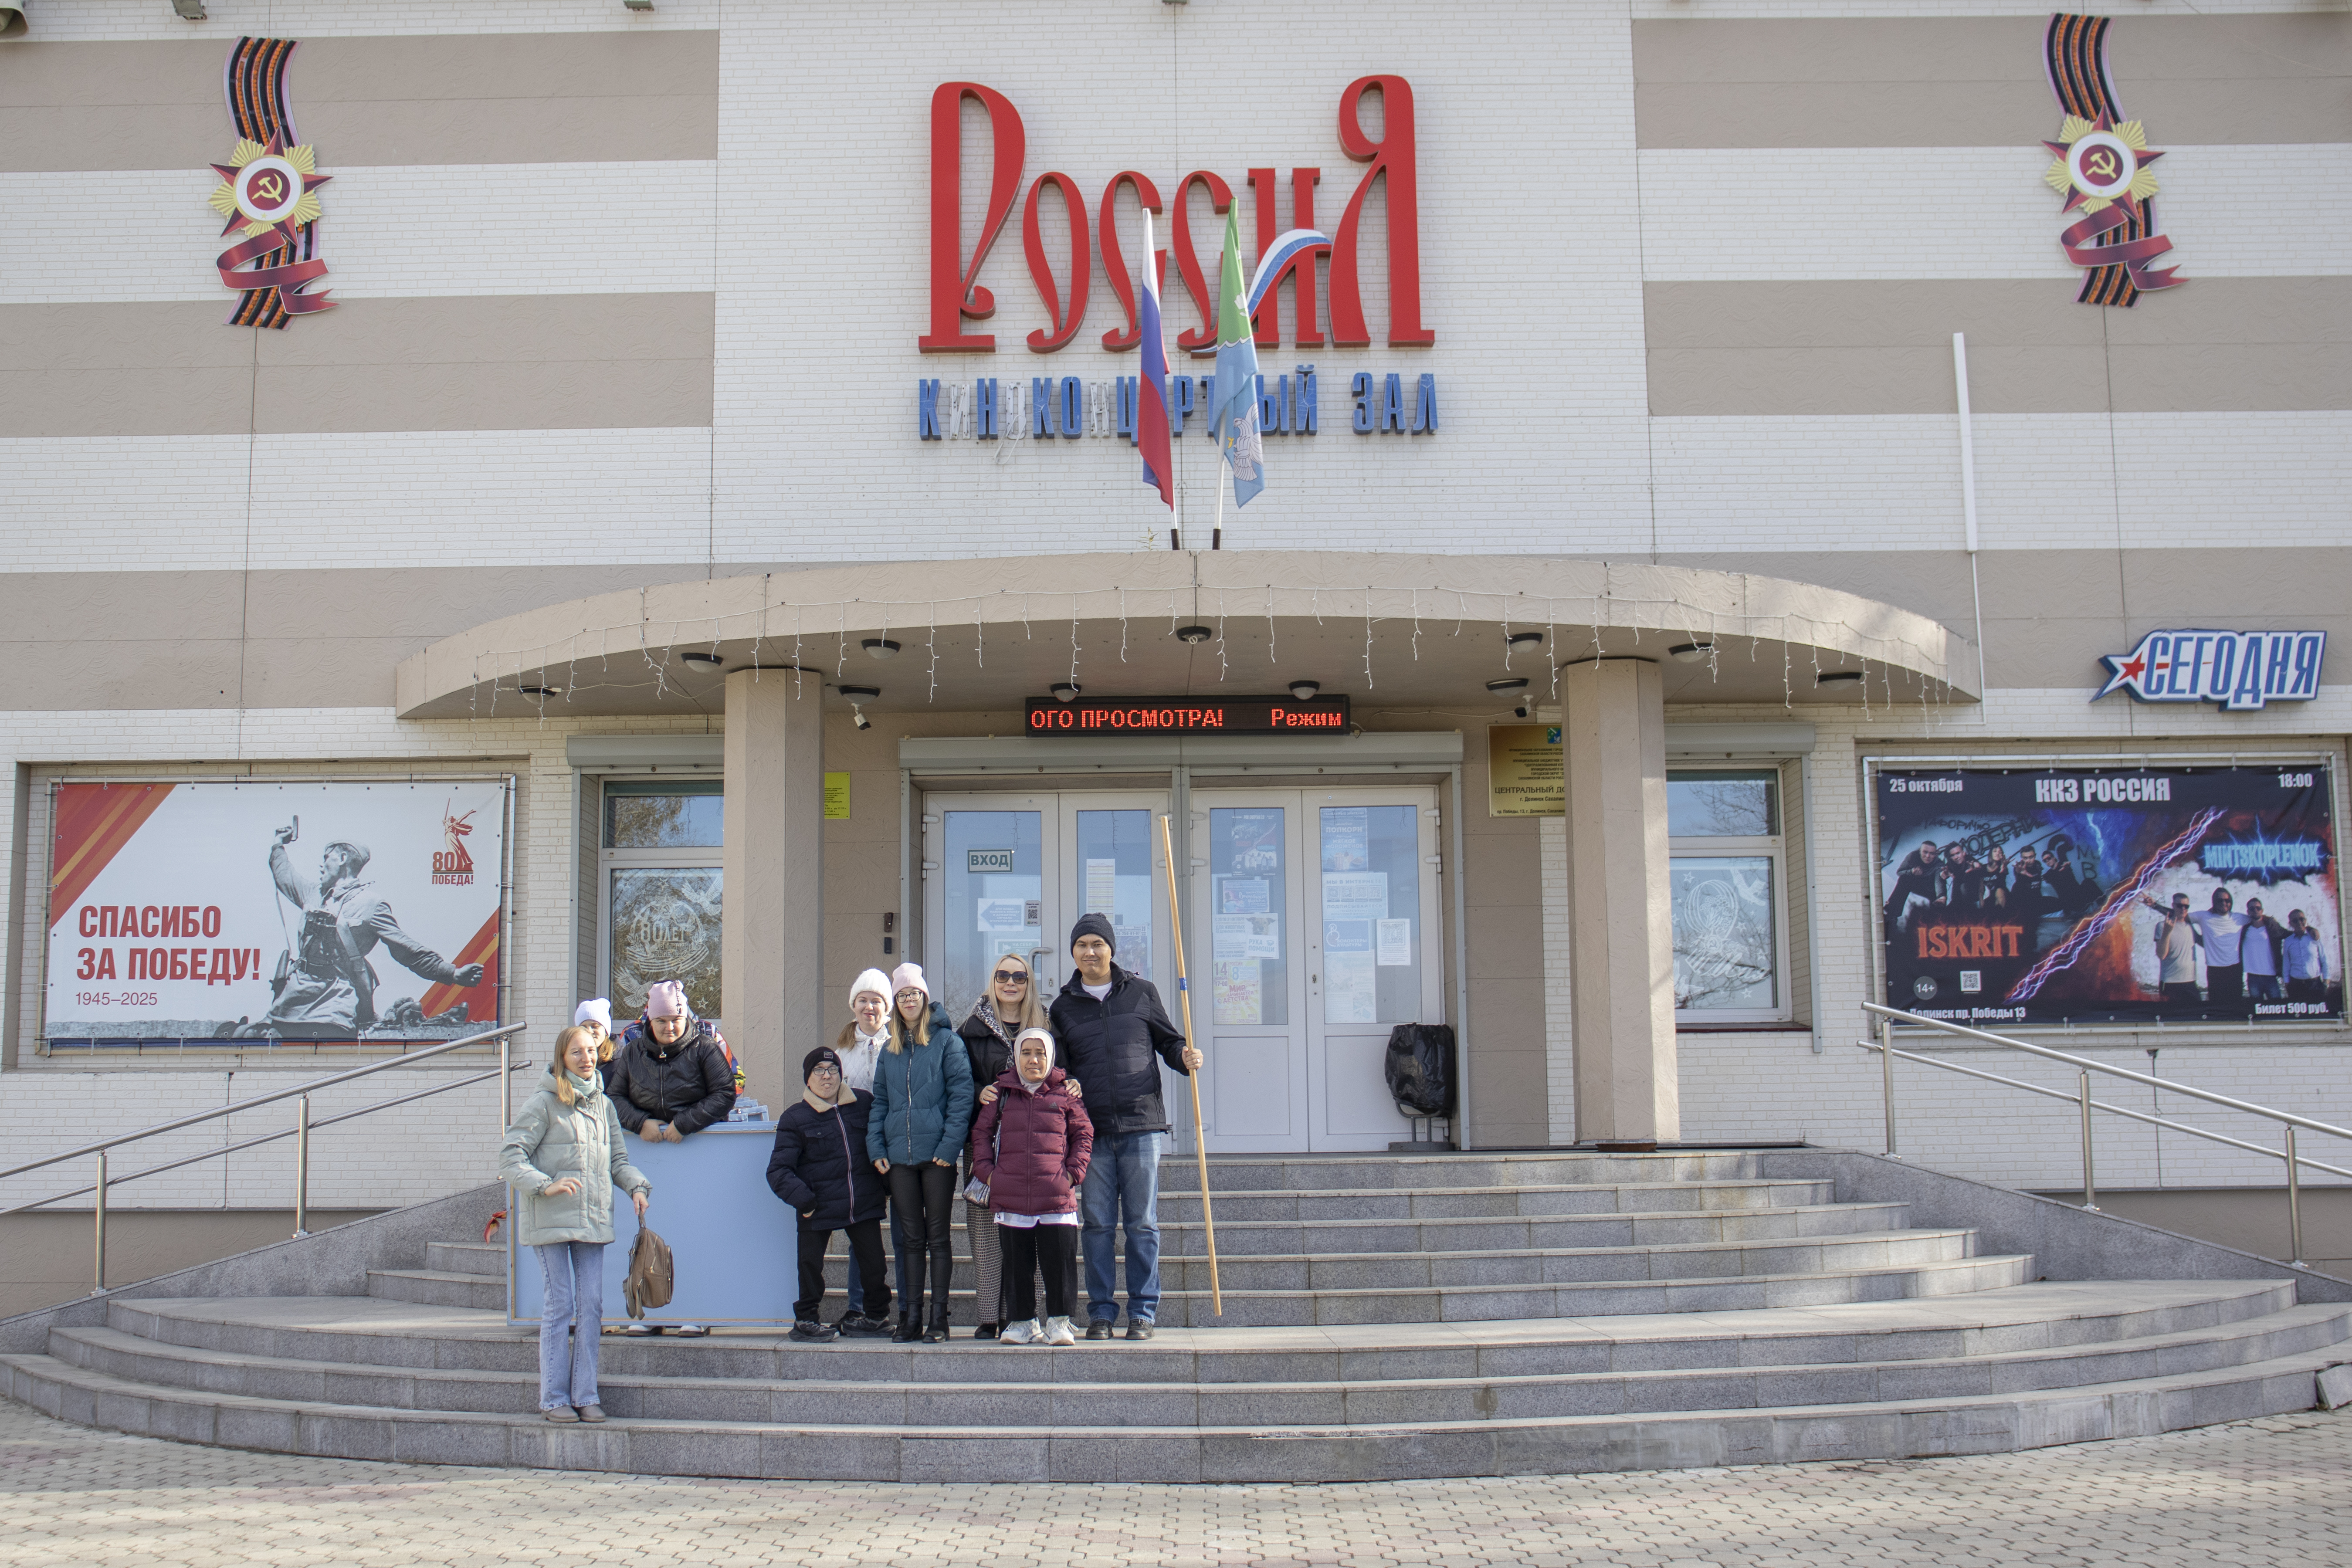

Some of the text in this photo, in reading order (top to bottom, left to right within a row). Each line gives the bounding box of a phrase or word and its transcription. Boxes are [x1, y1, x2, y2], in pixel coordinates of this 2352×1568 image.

[918, 75, 1434, 353] РОССИЯ
[919, 364, 1439, 447] КИНОКОНЦРТЫЙ ЗАЛ
[2144, 635, 2321, 704] СЕГОДНЯ
[1031, 708, 1342, 728] ОГО ПРОСМОТРА! Режим
[1889, 778, 1963, 793] 25 октября
[2277, 773, 2313, 788] 18:00
[1495, 786, 1554, 794] ЦЕНТРАЛЬНЫЙ
[2035, 778, 2170, 803] ККЗ РОССИЯ
[433, 851, 456, 871] 80
[971, 855, 1009, 867] ВХОД
[2203, 843, 2321, 869] MINTSKOPLENOK
[432, 874, 474, 886] ПОБЕДА!
[79, 905, 221, 938] СПАСИБО
[1917, 926, 2023, 958] ISKRIT
[77, 948, 261, 986] ЗА ПОБЕДУ!
[1214, 962, 1227, 976] 14
[1232, 966, 1239, 980] 8
[1915, 983, 1935, 993] 14+
[1223, 996, 1249, 1004] ДЕТСТВА
[1955, 1009, 1971, 1020] пр.
[1971, 1007, 2013, 1019] Победы
[2014, 1007, 2026, 1018] 13
[2254, 1002, 2329, 1015] Билет 500 руб.
